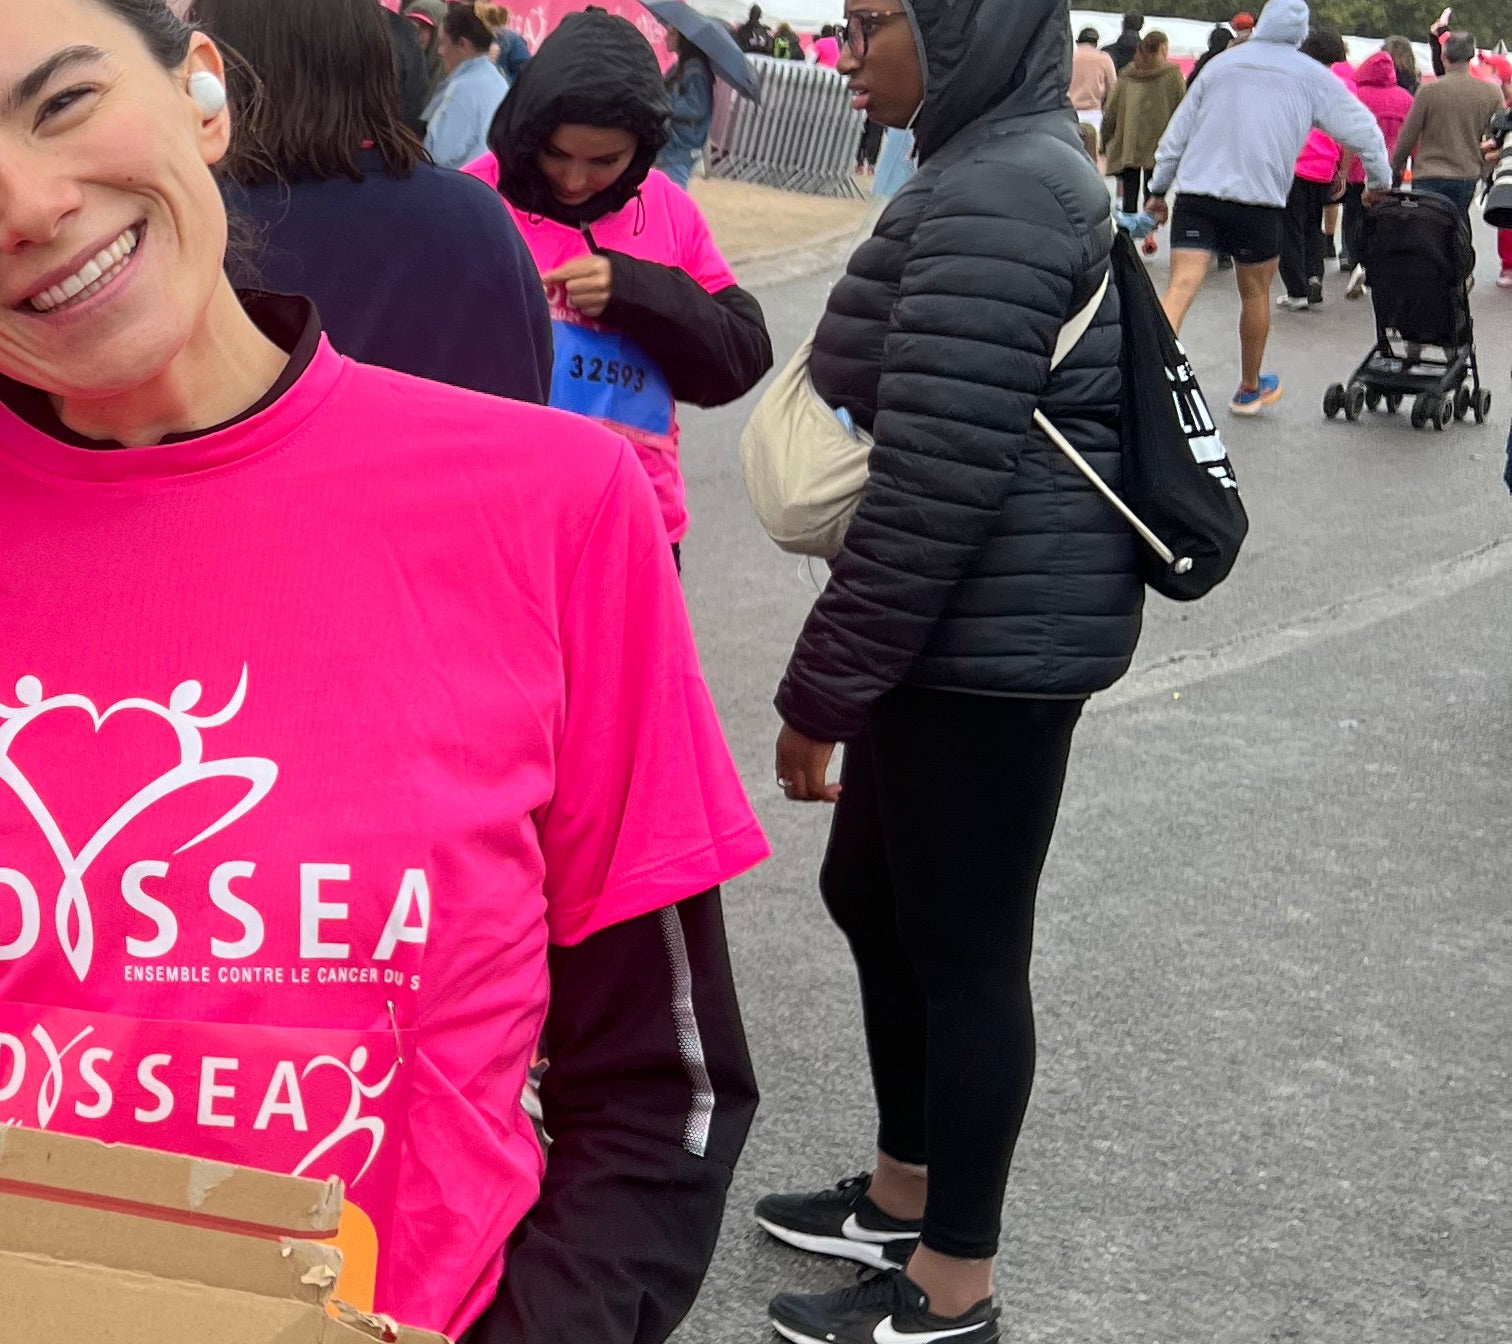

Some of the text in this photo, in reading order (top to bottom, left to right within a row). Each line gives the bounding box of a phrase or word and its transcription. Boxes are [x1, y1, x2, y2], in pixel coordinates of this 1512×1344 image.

[569, 354, 645, 393] 32593
[124, 964, 211, 983] ENSEMBLE
[217, 966, 284, 984] CONTRE
[291, 967, 311, 984] LE
[317, 966, 379, 984] CANCER
[383, 968, 405, 987] DU
